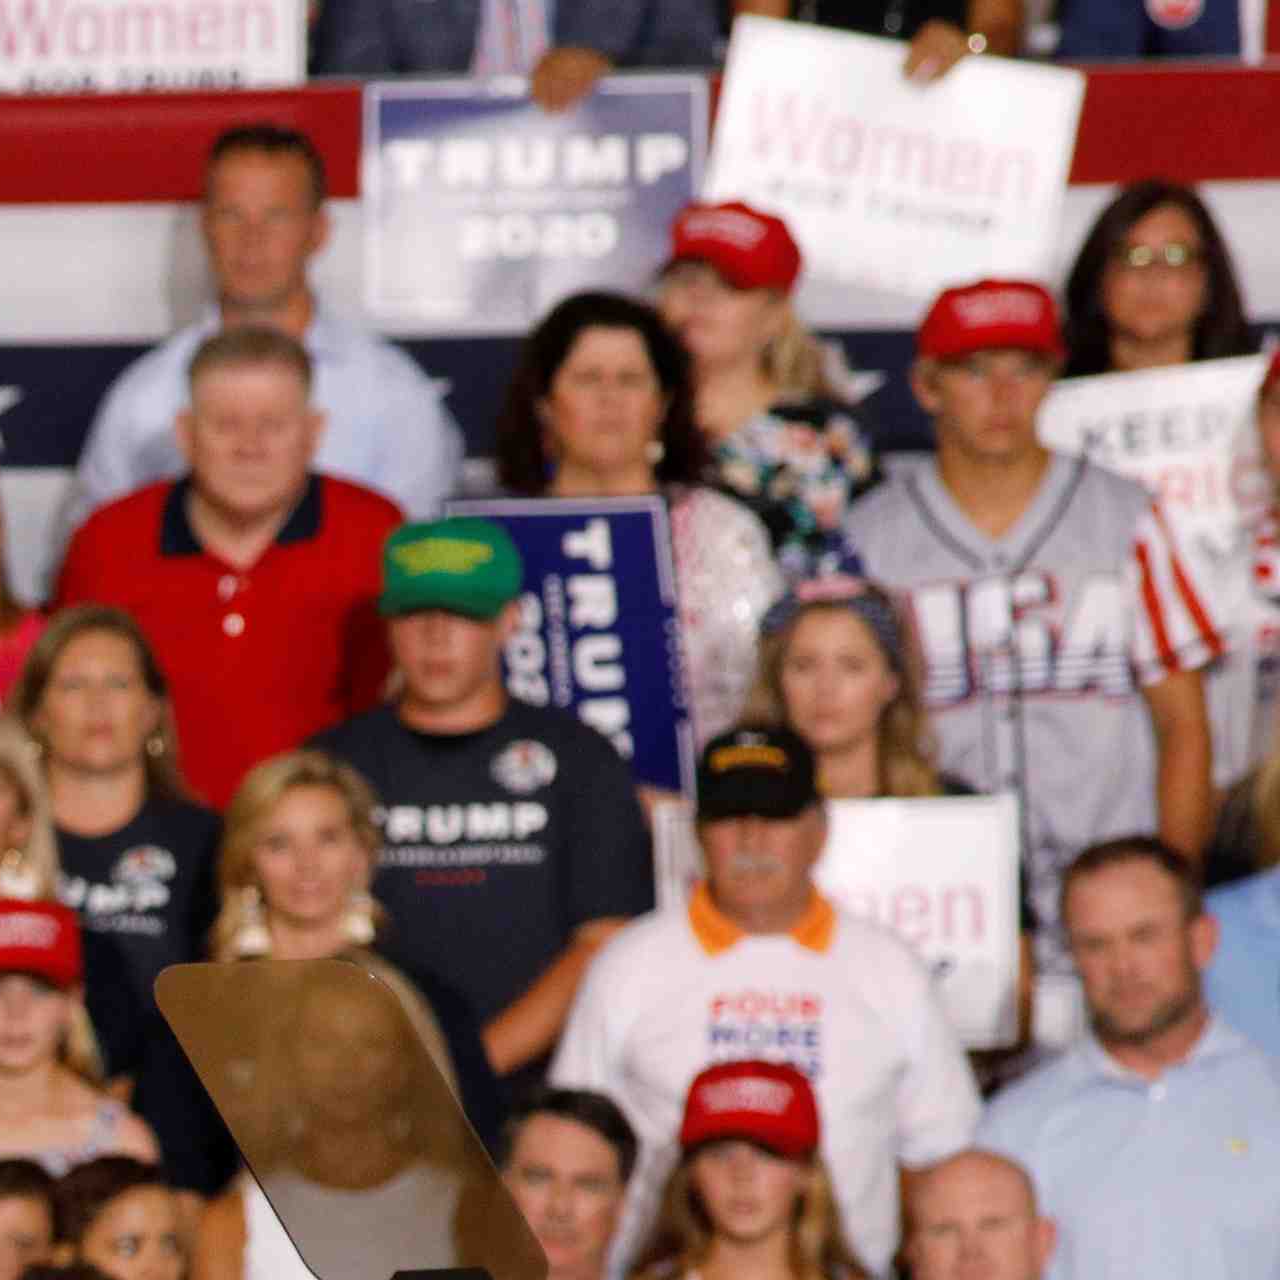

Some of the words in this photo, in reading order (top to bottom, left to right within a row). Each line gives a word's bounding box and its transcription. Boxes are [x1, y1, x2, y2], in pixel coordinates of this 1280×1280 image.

[386, 132, 688, 186] TRUMP
[560, 516, 635, 759] TRUM
[370, 801, 549, 845] RUMP
